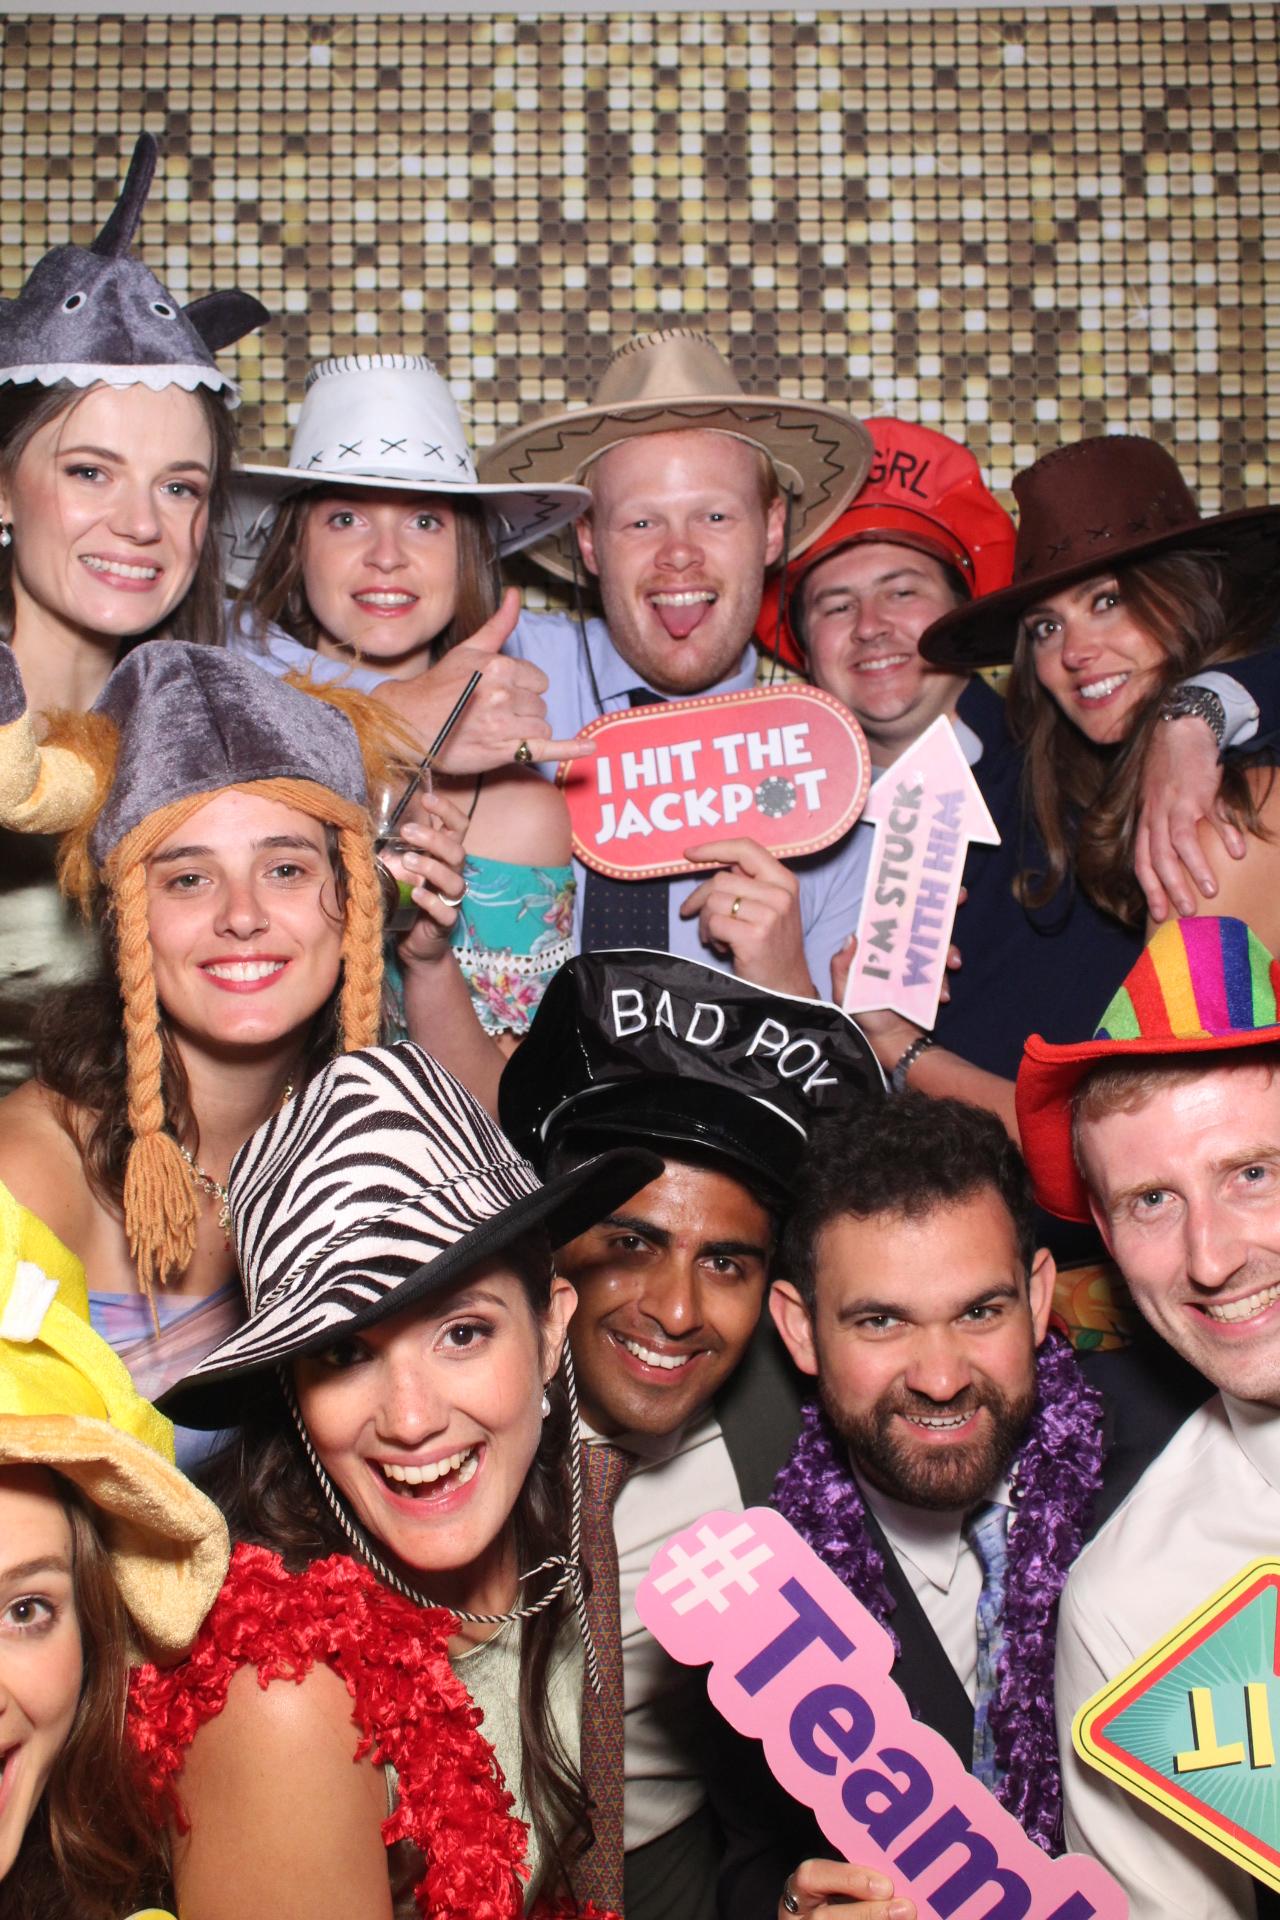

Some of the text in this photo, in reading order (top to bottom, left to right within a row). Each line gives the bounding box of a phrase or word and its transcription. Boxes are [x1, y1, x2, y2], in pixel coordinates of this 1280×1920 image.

[867, 448, 931, 500] GRL
[596, 722, 812, 795] I HIT THE
[861, 780, 926, 981] I'M STUCK
[901, 789, 967, 988] WITH HIM
[611, 988, 839, 1094] BAD BOY
[652, 1521, 1097, 1920] #Team
